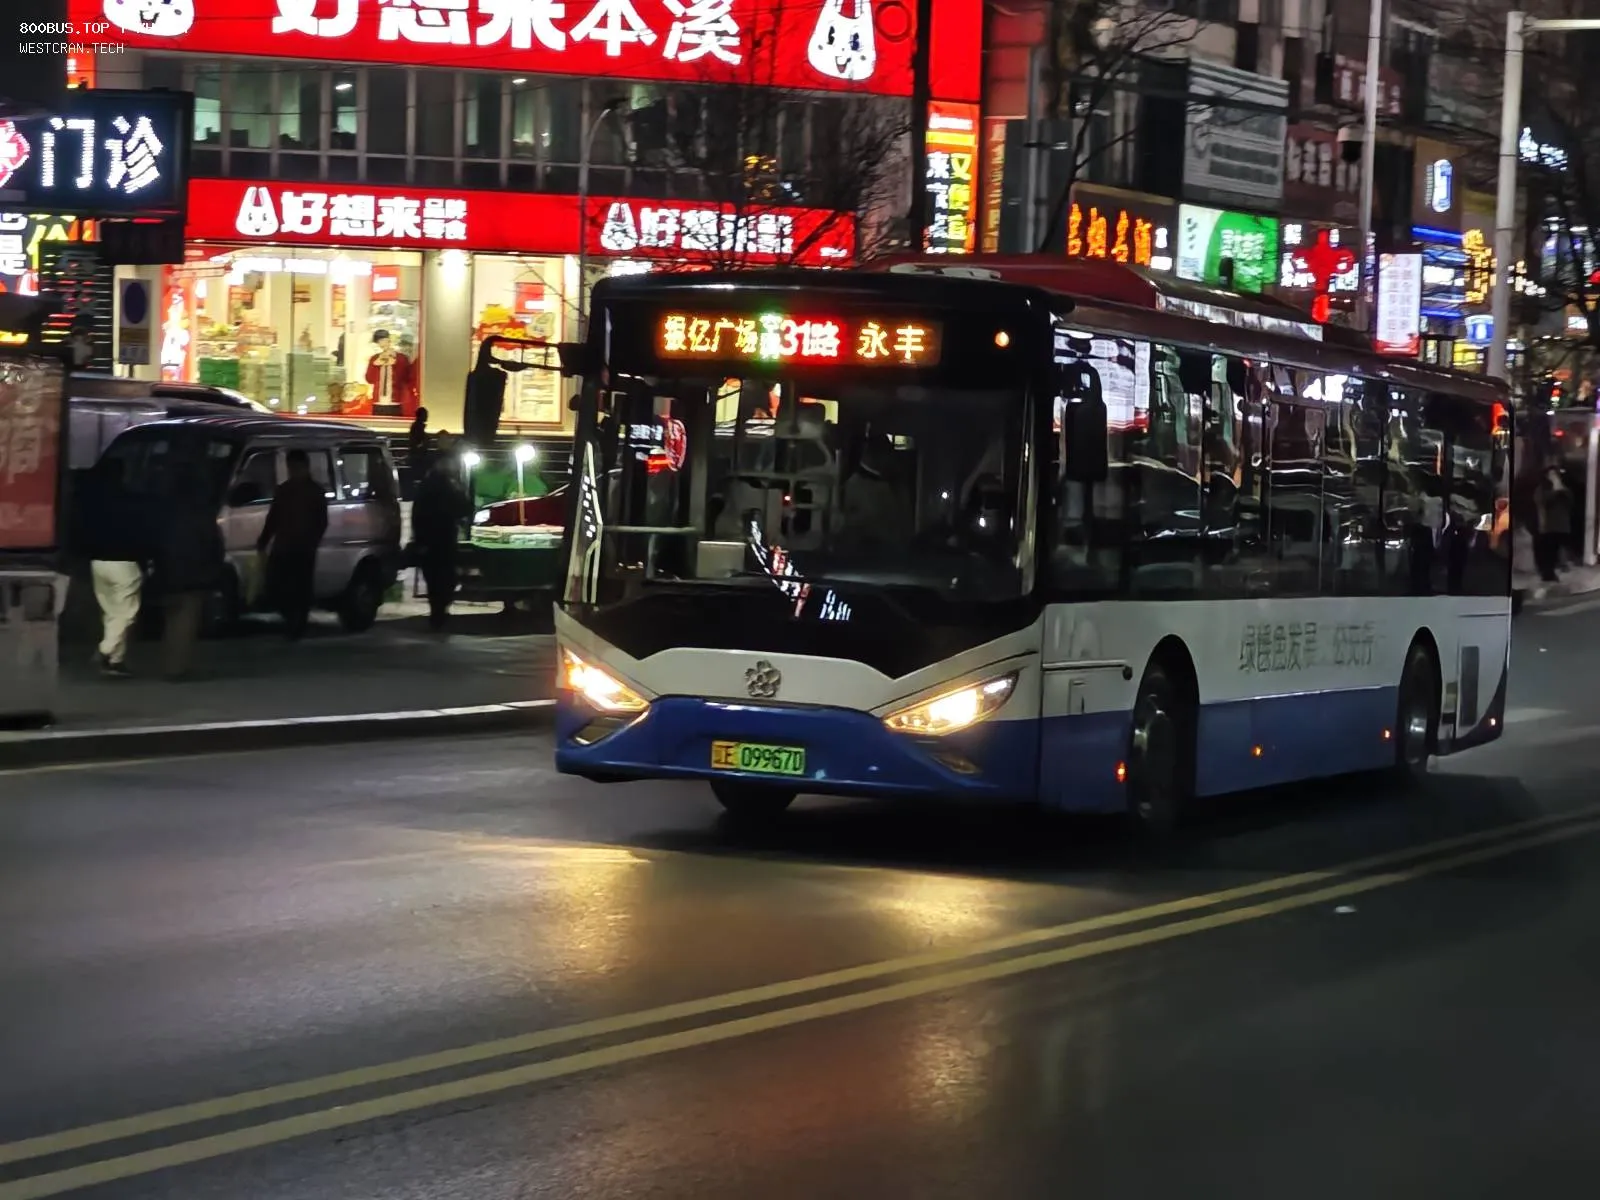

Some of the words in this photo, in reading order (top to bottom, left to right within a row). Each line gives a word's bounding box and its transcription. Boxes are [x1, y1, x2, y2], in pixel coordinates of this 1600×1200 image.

[41, 115, 164, 194] 门诊
[280, 191, 422, 238] 好想来
[856, 321, 926, 359] 永丰
